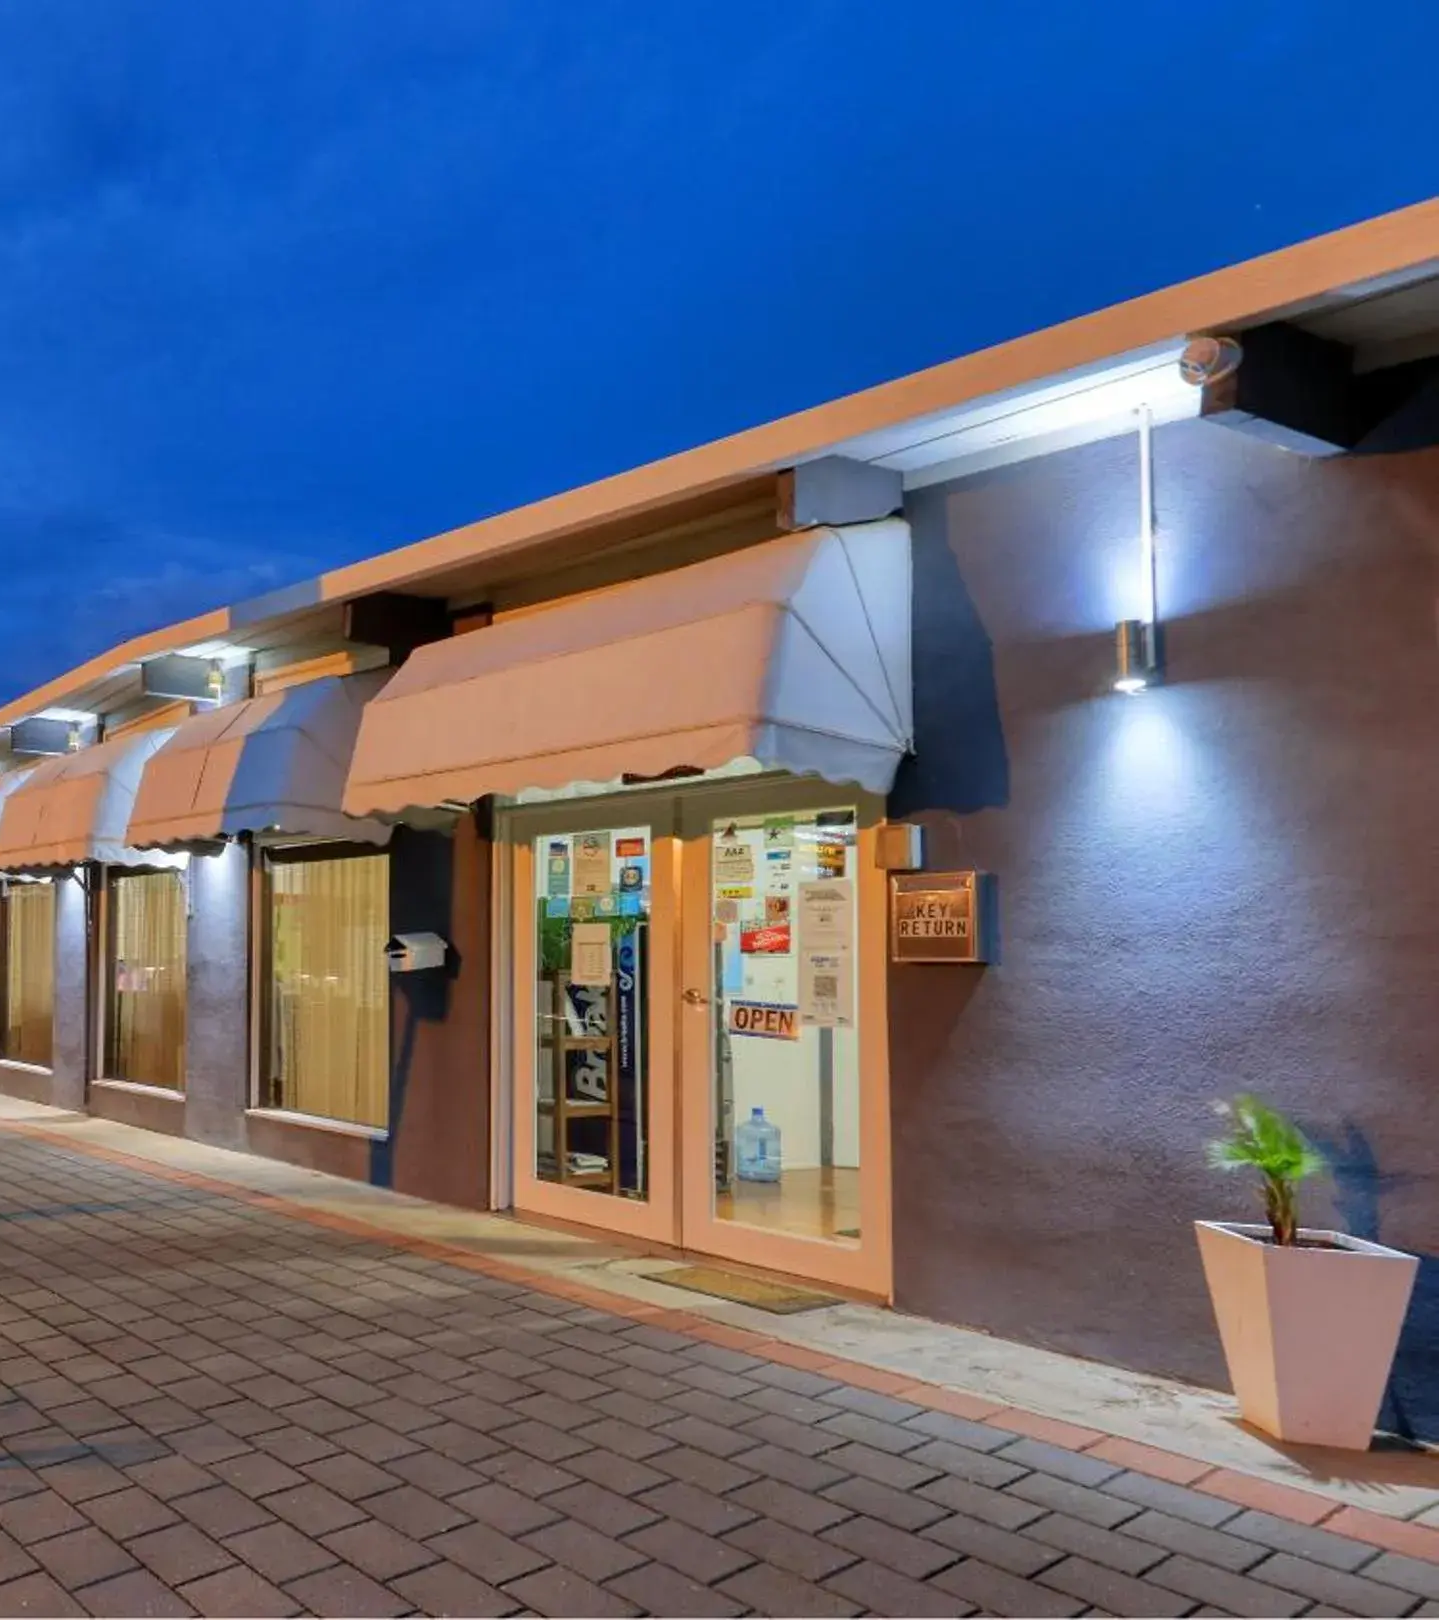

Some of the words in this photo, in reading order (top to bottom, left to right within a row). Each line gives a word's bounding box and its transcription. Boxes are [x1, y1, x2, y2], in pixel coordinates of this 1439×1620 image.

[915, 902, 949, 919] KEY
[900, 919, 967, 936] RETURN
[734, 1005, 794, 1034] OPEN
